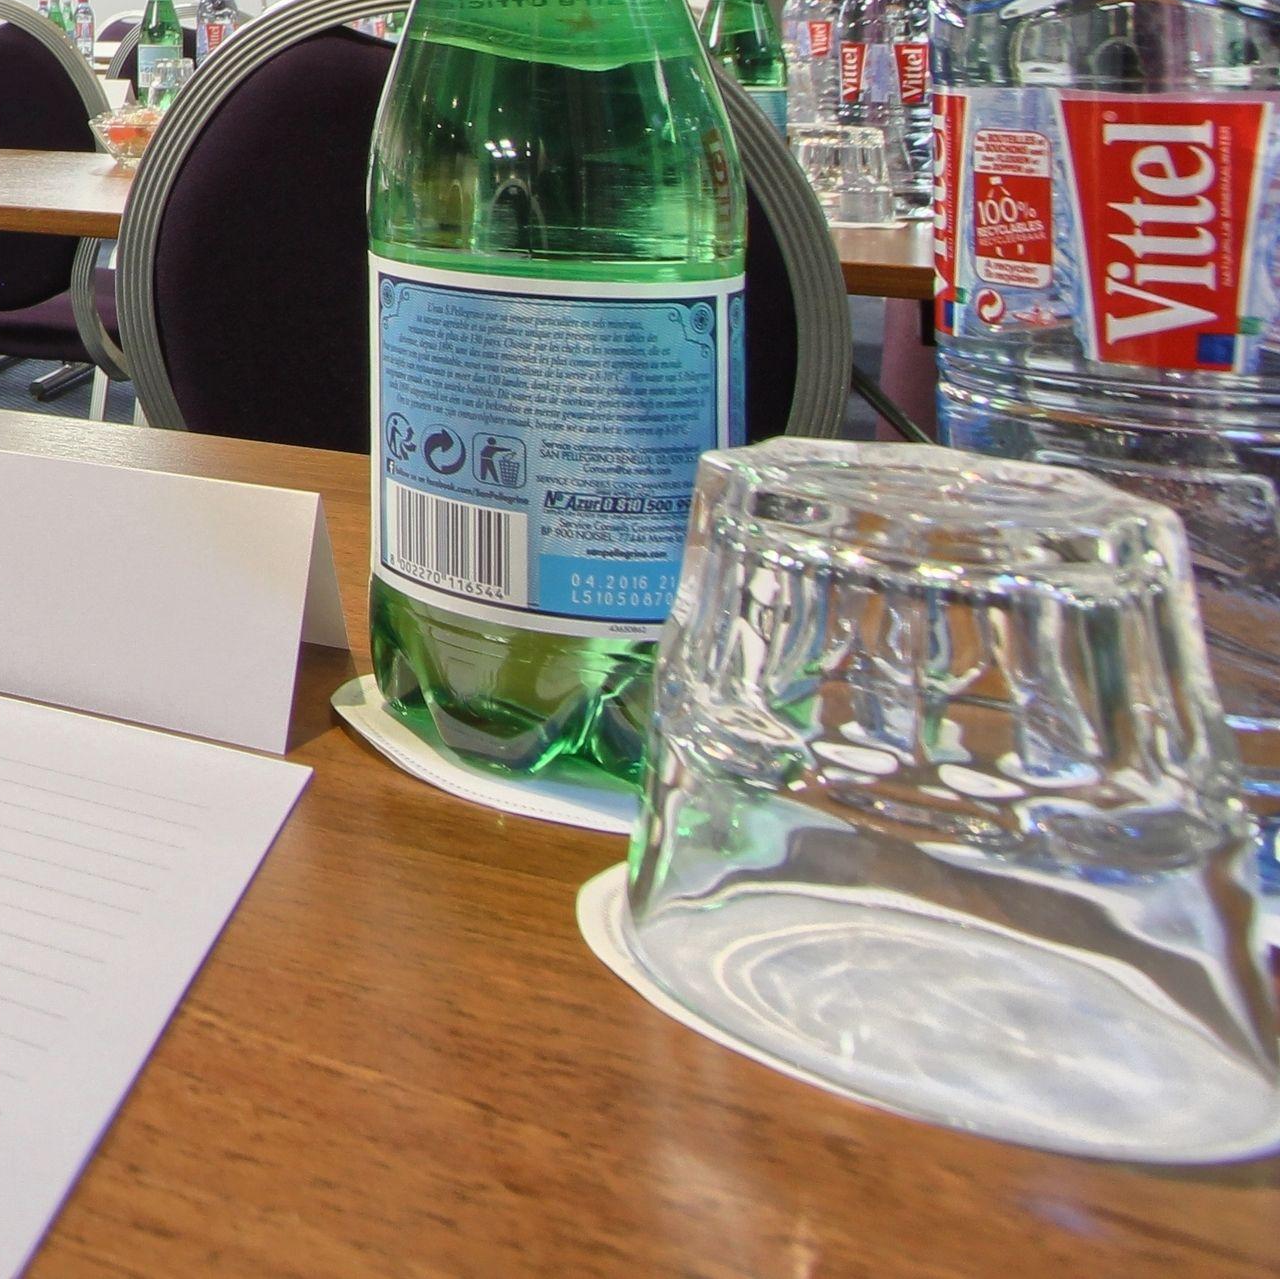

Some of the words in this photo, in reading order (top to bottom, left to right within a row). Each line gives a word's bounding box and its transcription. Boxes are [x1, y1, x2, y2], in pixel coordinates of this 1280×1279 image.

[811, 24, 828, 54] Vittel
[842, 47, 858, 96] Vittel
[902, 48, 925, 97] Vittel
[977, 196, 1038, 226] 100%
[977, 221, 1045, 238] RECYCLABLES
[1103, 120, 1218, 344] Vittel
[539, 448, 559, 459] SAN
[615, 497, 641, 512] 810
[646, 499, 671, 511] 500
[675, 498, 690, 510] 99
[399, 559, 441, 584] 002270
[448, 574, 504, 600] 116544
